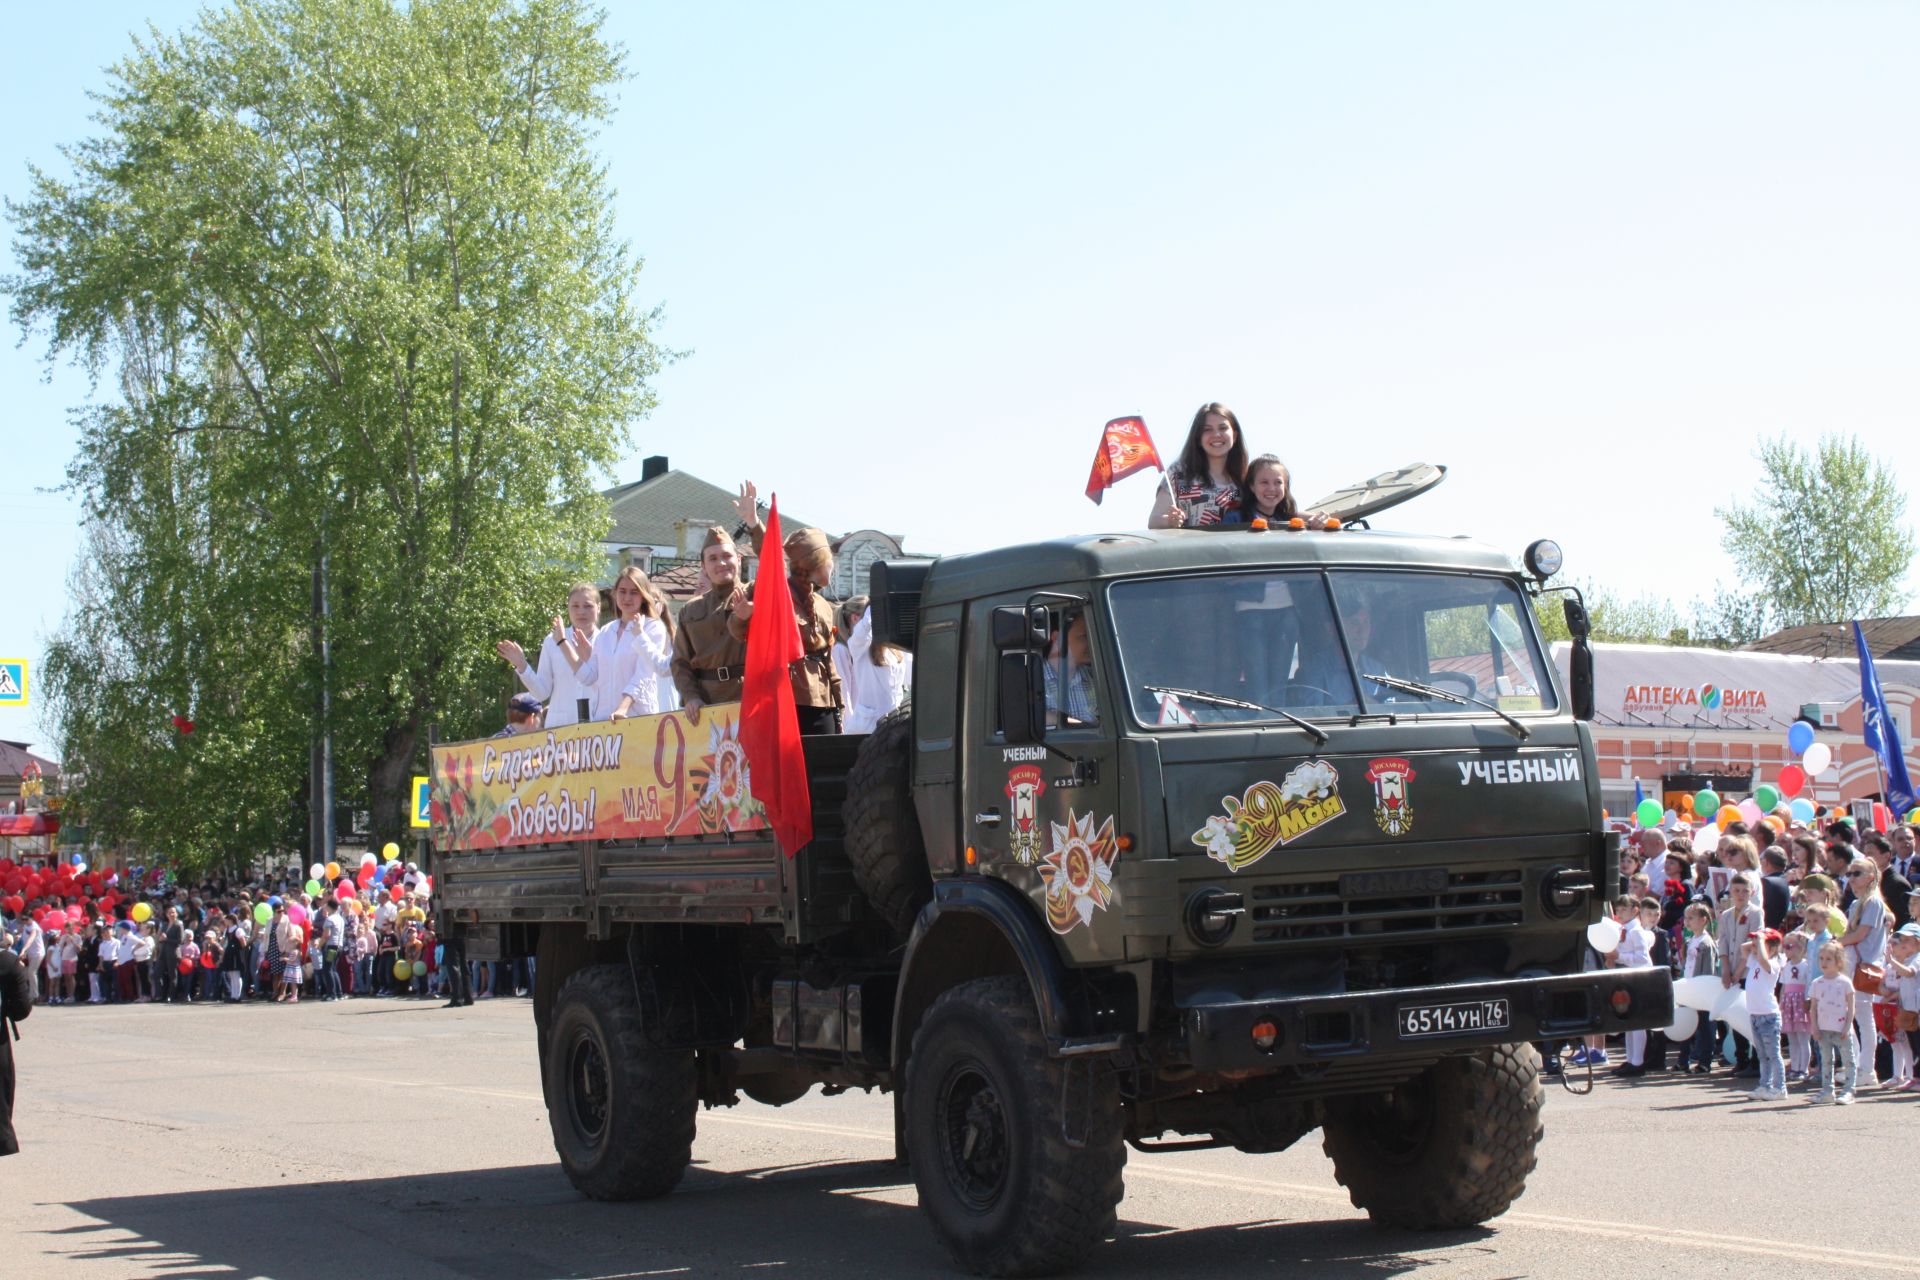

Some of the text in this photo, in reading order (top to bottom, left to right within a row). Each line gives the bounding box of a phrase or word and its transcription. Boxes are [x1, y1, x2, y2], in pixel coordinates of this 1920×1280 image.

[1625, 685, 1767, 708] АПТЕКА ВИТА
[481, 731, 624, 789] С праздником
[622, 713, 687, 835] 9 МАЯ
[1457, 752, 1581, 786] УЧЕБНЫЙ
[507, 788, 598, 838] Победы!
[1278, 794, 1342, 842] Мая
[1407, 1007, 1455, 1033] 6514
[1485, 1002, 1503, 1020] 76
[1487, 1019, 1501, 1027] RUS
